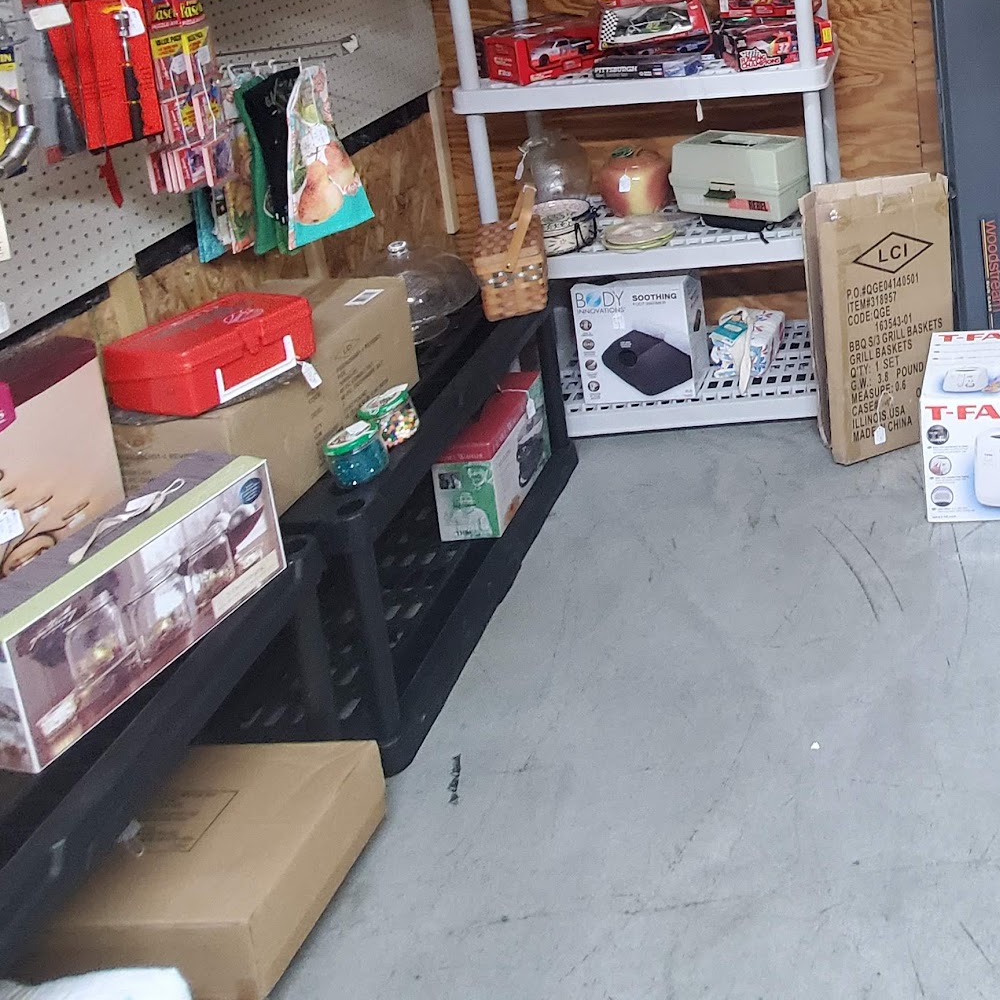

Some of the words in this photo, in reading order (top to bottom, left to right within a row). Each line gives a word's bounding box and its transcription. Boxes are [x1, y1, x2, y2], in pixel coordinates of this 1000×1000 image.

[748, 200, 768, 211] REBEL
[878, 243, 908, 263] LCI
[631, 292, 677, 302] SOOTHING
[847, 291, 897, 313] ITEM#318957
[875, 313, 912, 332] 163543-01
[849, 338, 867, 352] BBQ
[868, 334, 880, 347] S/3
[882, 328, 906, 343] GRILL
[907, 317, 943, 337] BASKETS
[849, 350, 874, 365] GRILL
[875, 339, 913, 358] BASKETS
[883, 355, 900, 369] SET
[896, 361, 924, 378] POUND
[853, 426, 877, 442] MADE
[888, 415, 912, 431] CHINA
